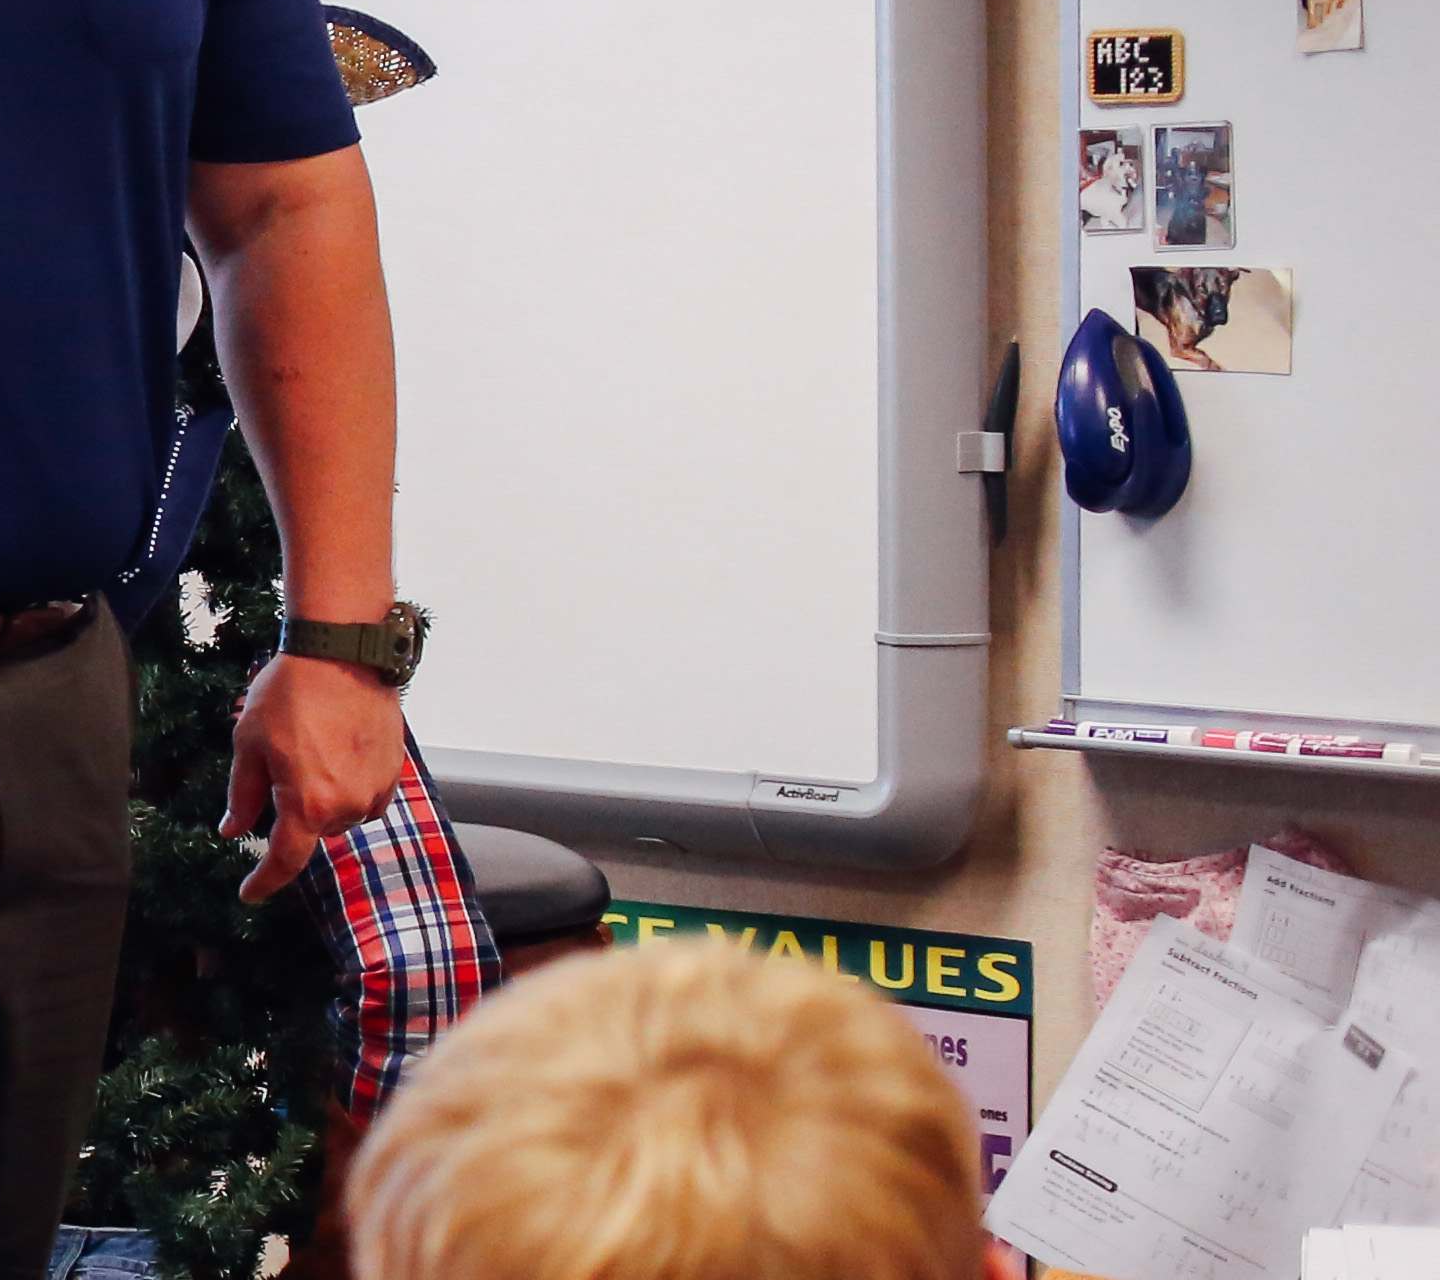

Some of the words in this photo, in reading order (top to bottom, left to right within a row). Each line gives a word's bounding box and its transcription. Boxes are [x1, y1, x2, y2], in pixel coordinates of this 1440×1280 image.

[1097, 36, 1151, 65] ABC
[1120, 67, 1164, 94] 123
[1107, 406, 1130, 453] EXPO
[1094, 727, 1135, 741] EXPO
[776, 785, 840, 803] ActivBoard
[1266, 874, 1287, 889] Add
[1289, 882, 1336, 908] Fractions
[1166, 946, 1212, 976] Subtract
[1212, 969, 1260, 1001] Fractions
